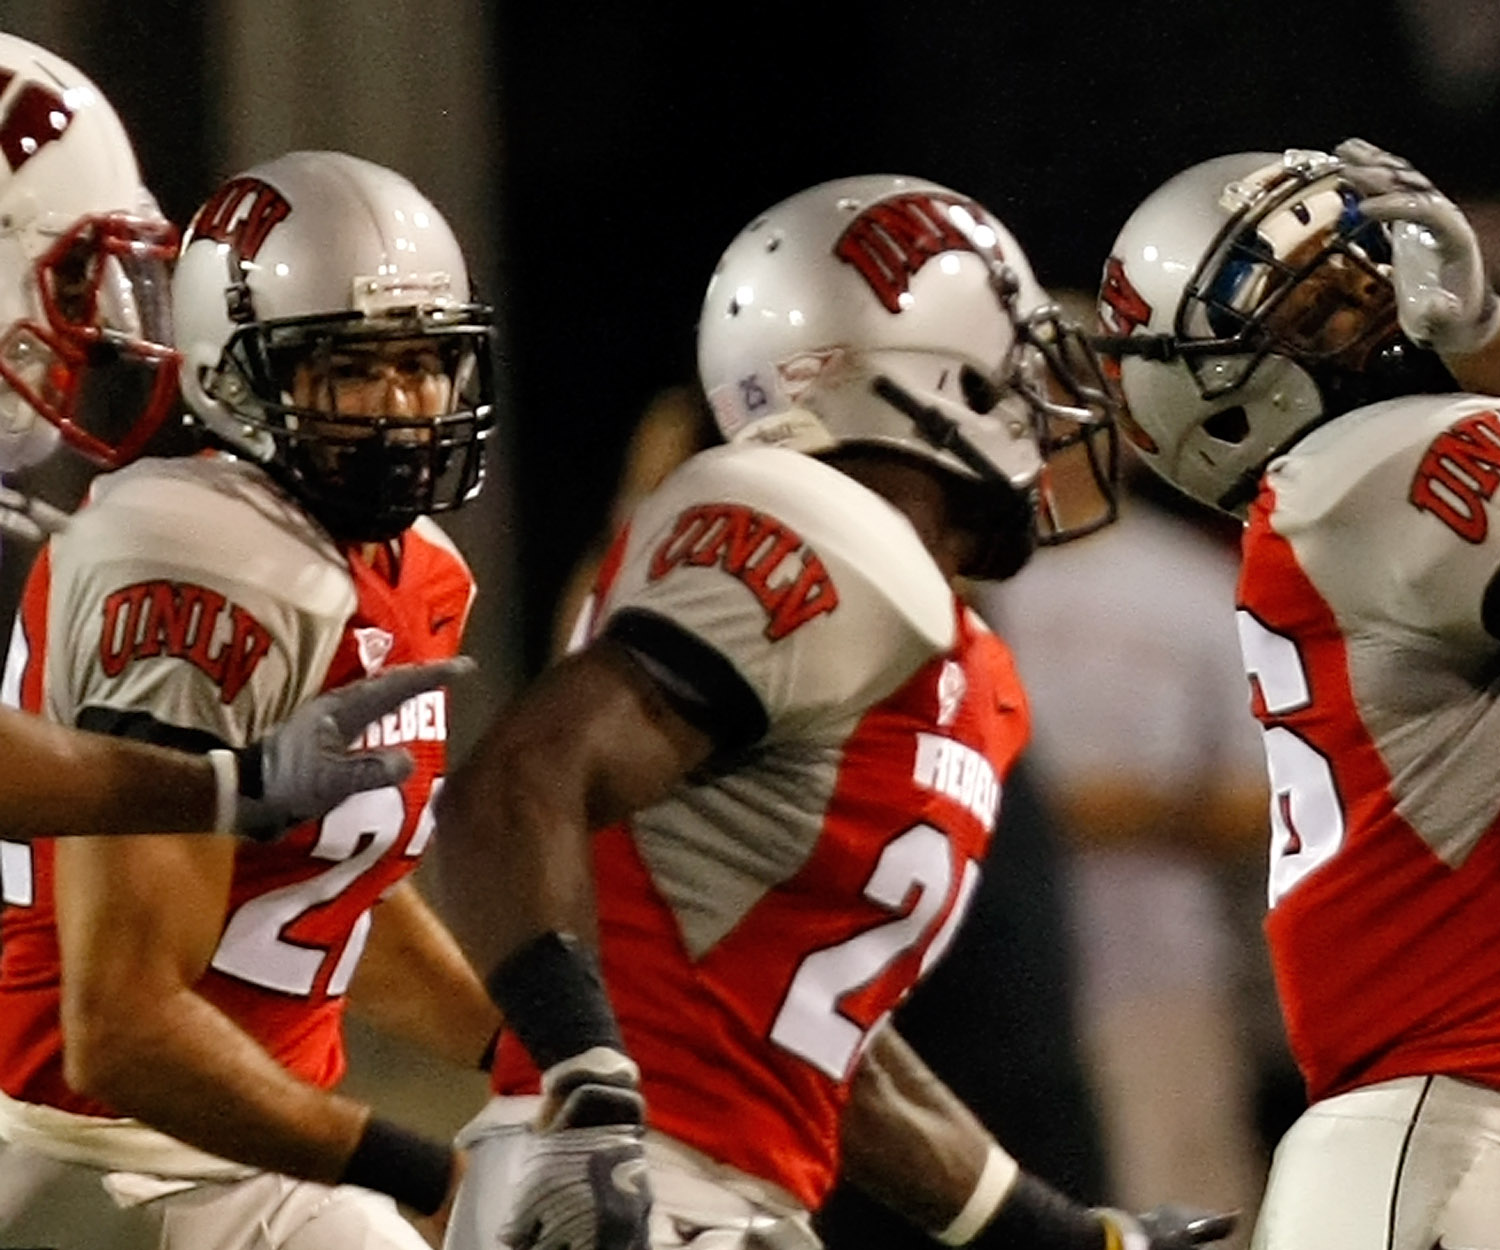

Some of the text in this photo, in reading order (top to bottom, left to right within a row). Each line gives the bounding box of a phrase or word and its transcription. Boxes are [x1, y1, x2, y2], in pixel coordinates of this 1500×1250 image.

[101, 578, 272, 705] UNLV
[647, 502, 840, 644] UNLV
[211, 777, 445, 997] 2
